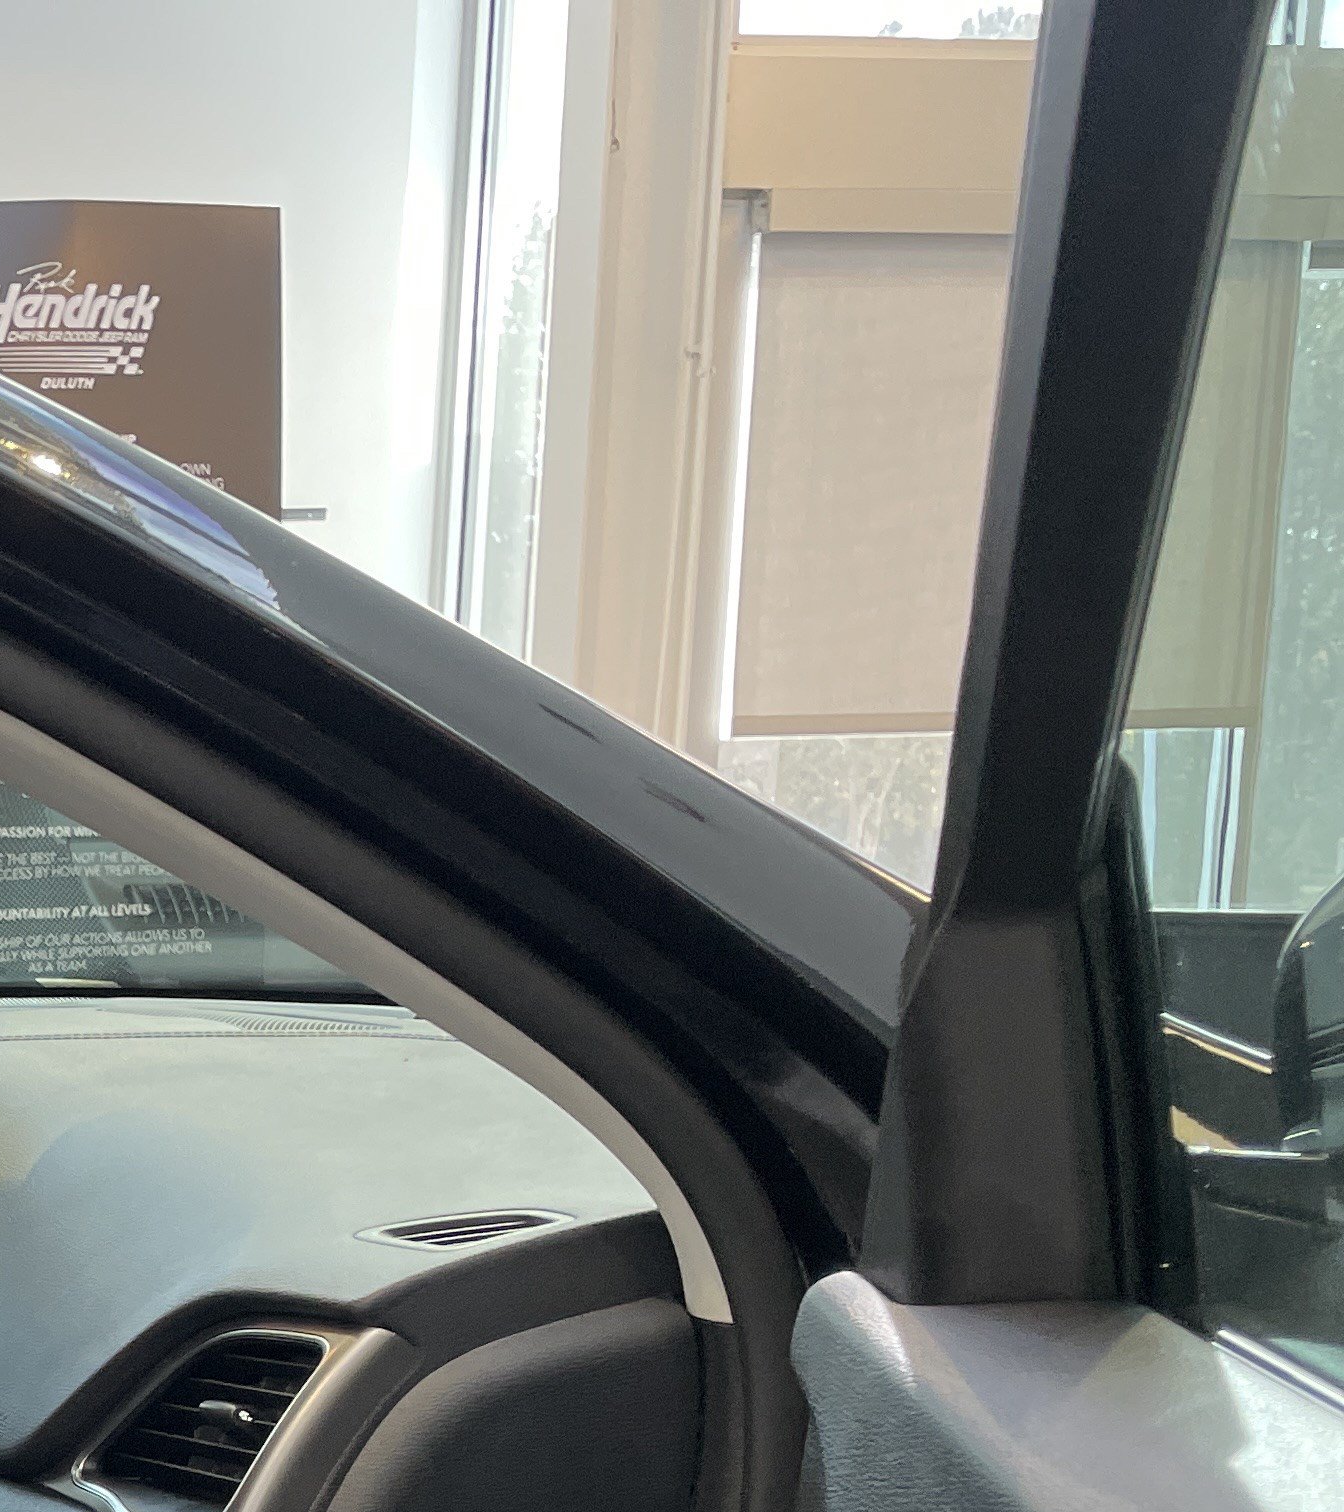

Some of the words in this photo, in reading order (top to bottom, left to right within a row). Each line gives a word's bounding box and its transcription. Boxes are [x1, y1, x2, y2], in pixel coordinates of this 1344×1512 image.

[40, 376, 96, 390] DULUTH
[47, 826, 71, 838] FOR
[71, 905, 89, 918] AT
[89, 904, 110, 917] ALL
[111, 903, 152, 917] LEVELS
[25, 934, 43, 948] OF
[72, 931, 123, 946] ACTIONS
[125, 929, 171, 942] ALLOWS
[172, 928, 188, 940] US
[190, 927, 206, 940] TO
[130, 943, 158, 956] ONE
[158, 940, 212, 955] ANOTHER
